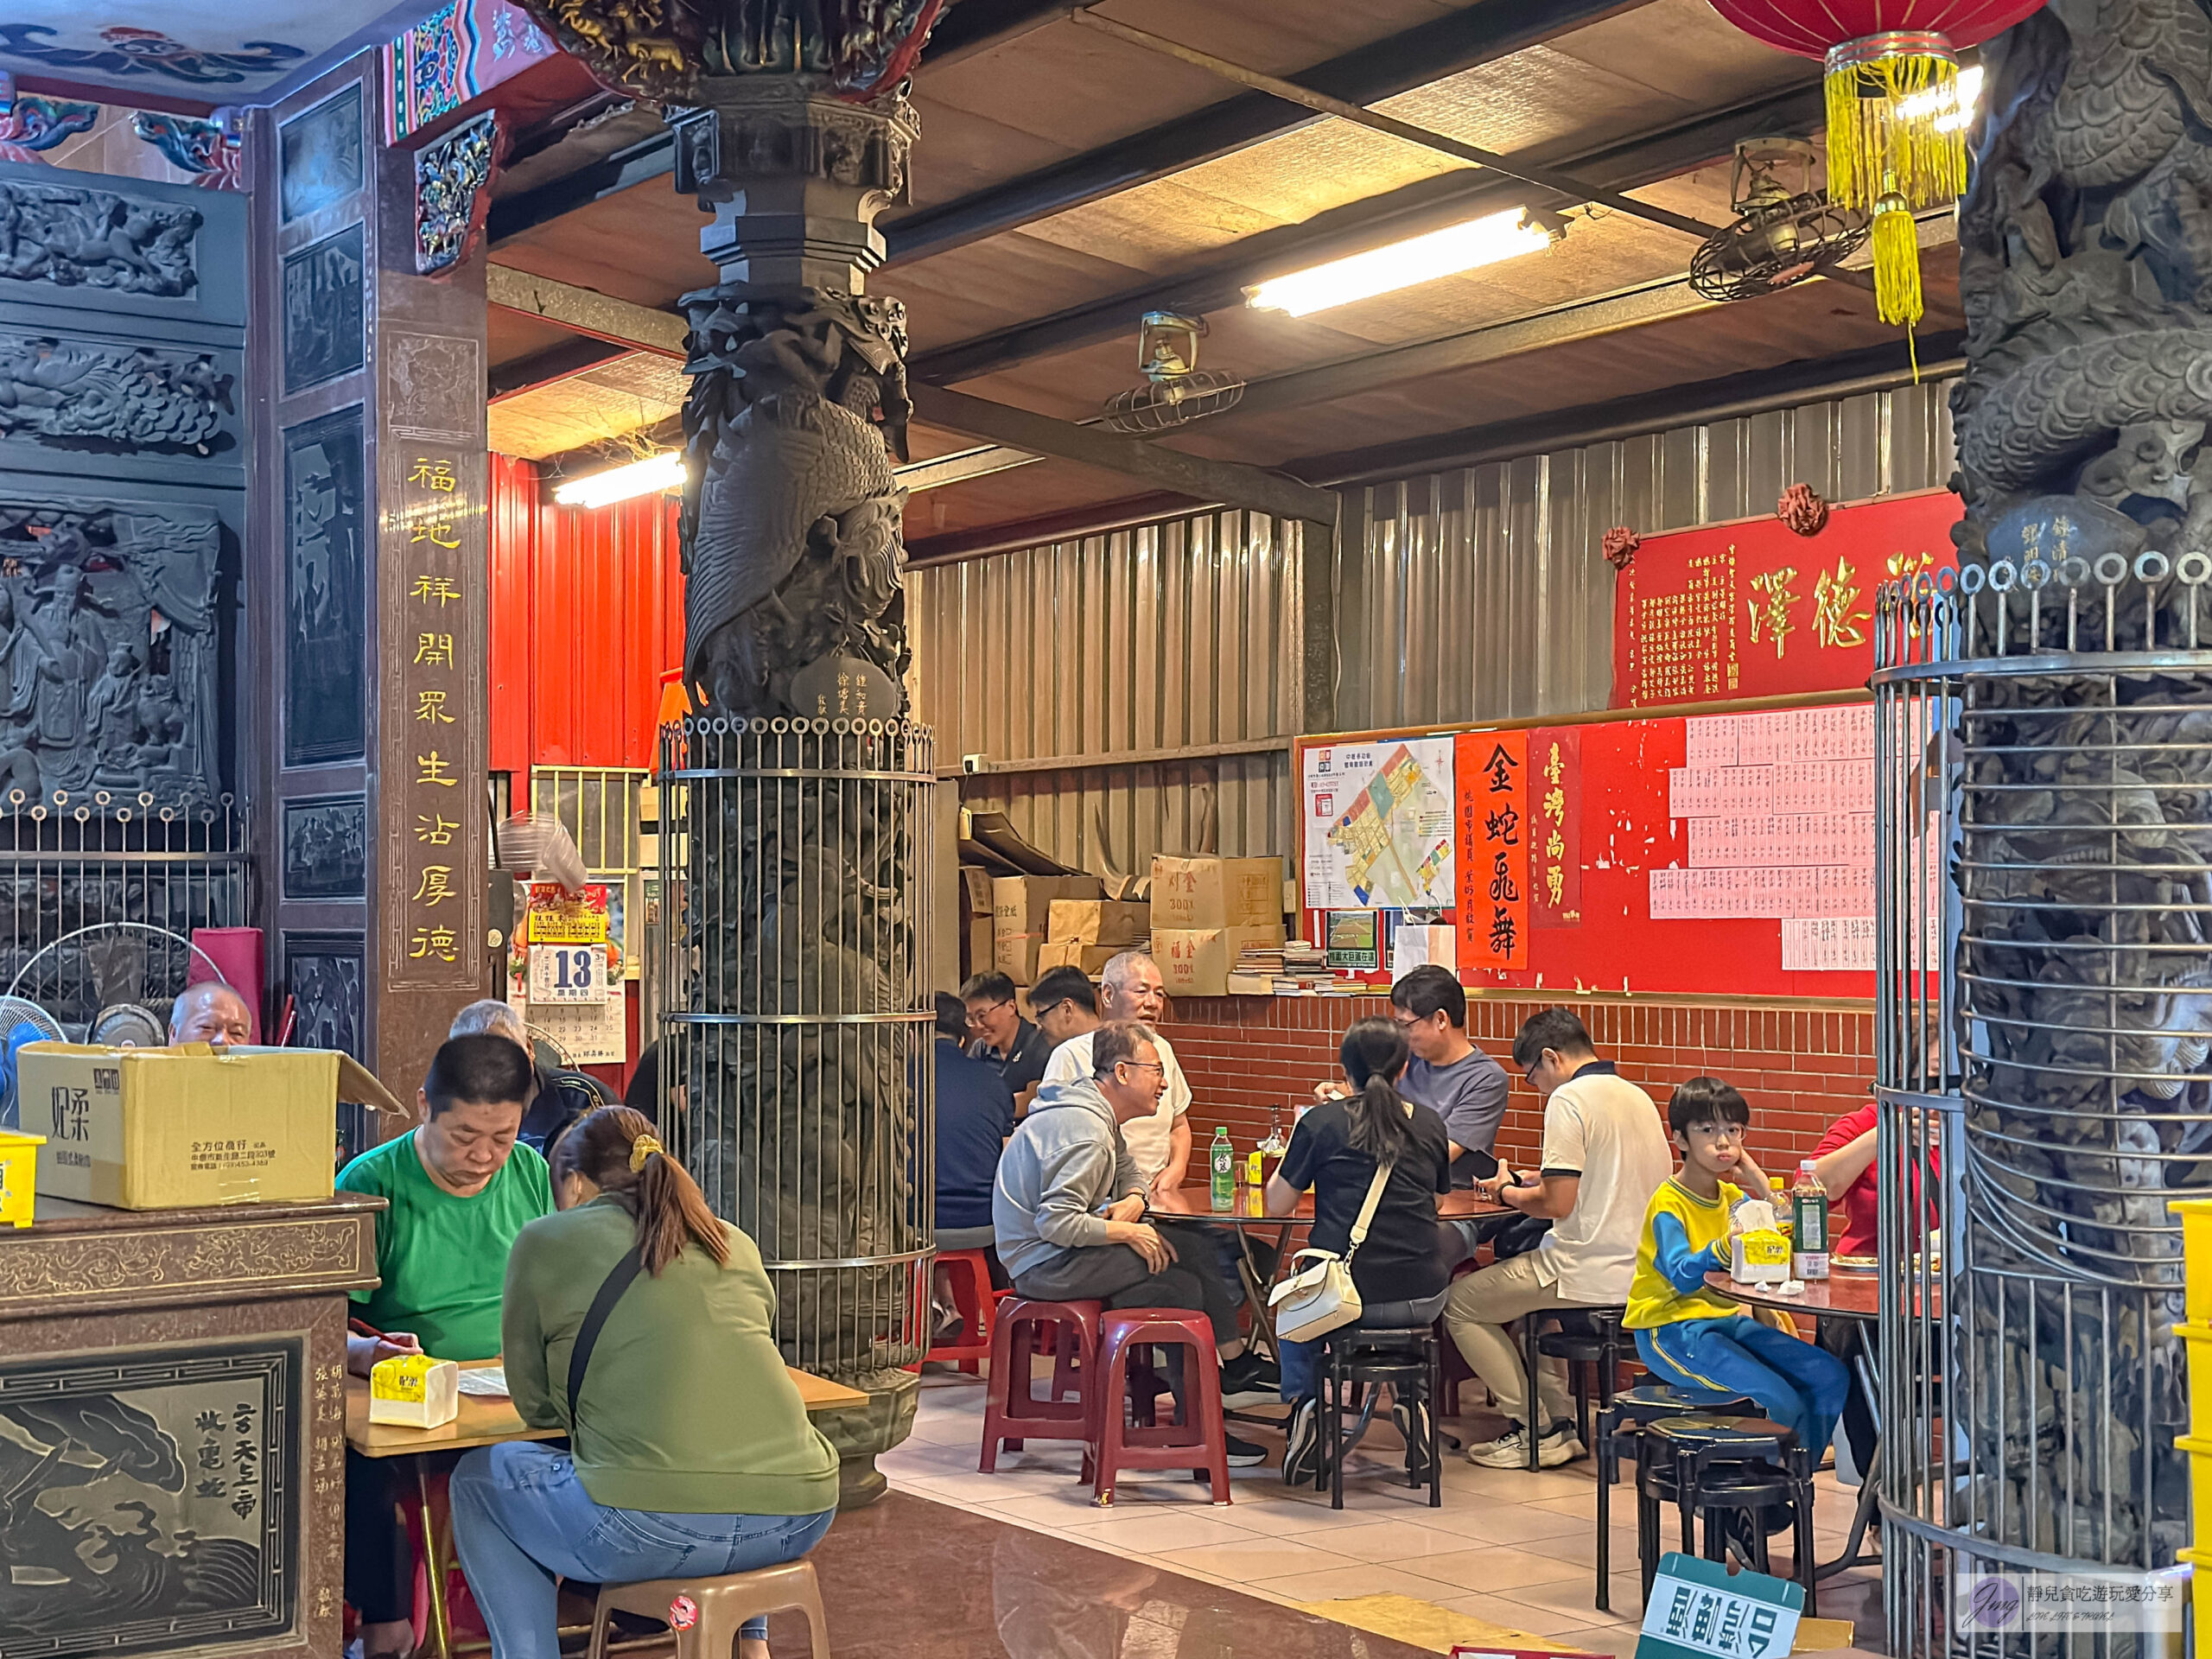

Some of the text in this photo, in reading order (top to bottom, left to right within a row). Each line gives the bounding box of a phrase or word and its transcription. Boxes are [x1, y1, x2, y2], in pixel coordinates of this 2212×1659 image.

[1543, 741, 1565, 908] 臺灣尚勇
[554, 950, 591, 988] 13
